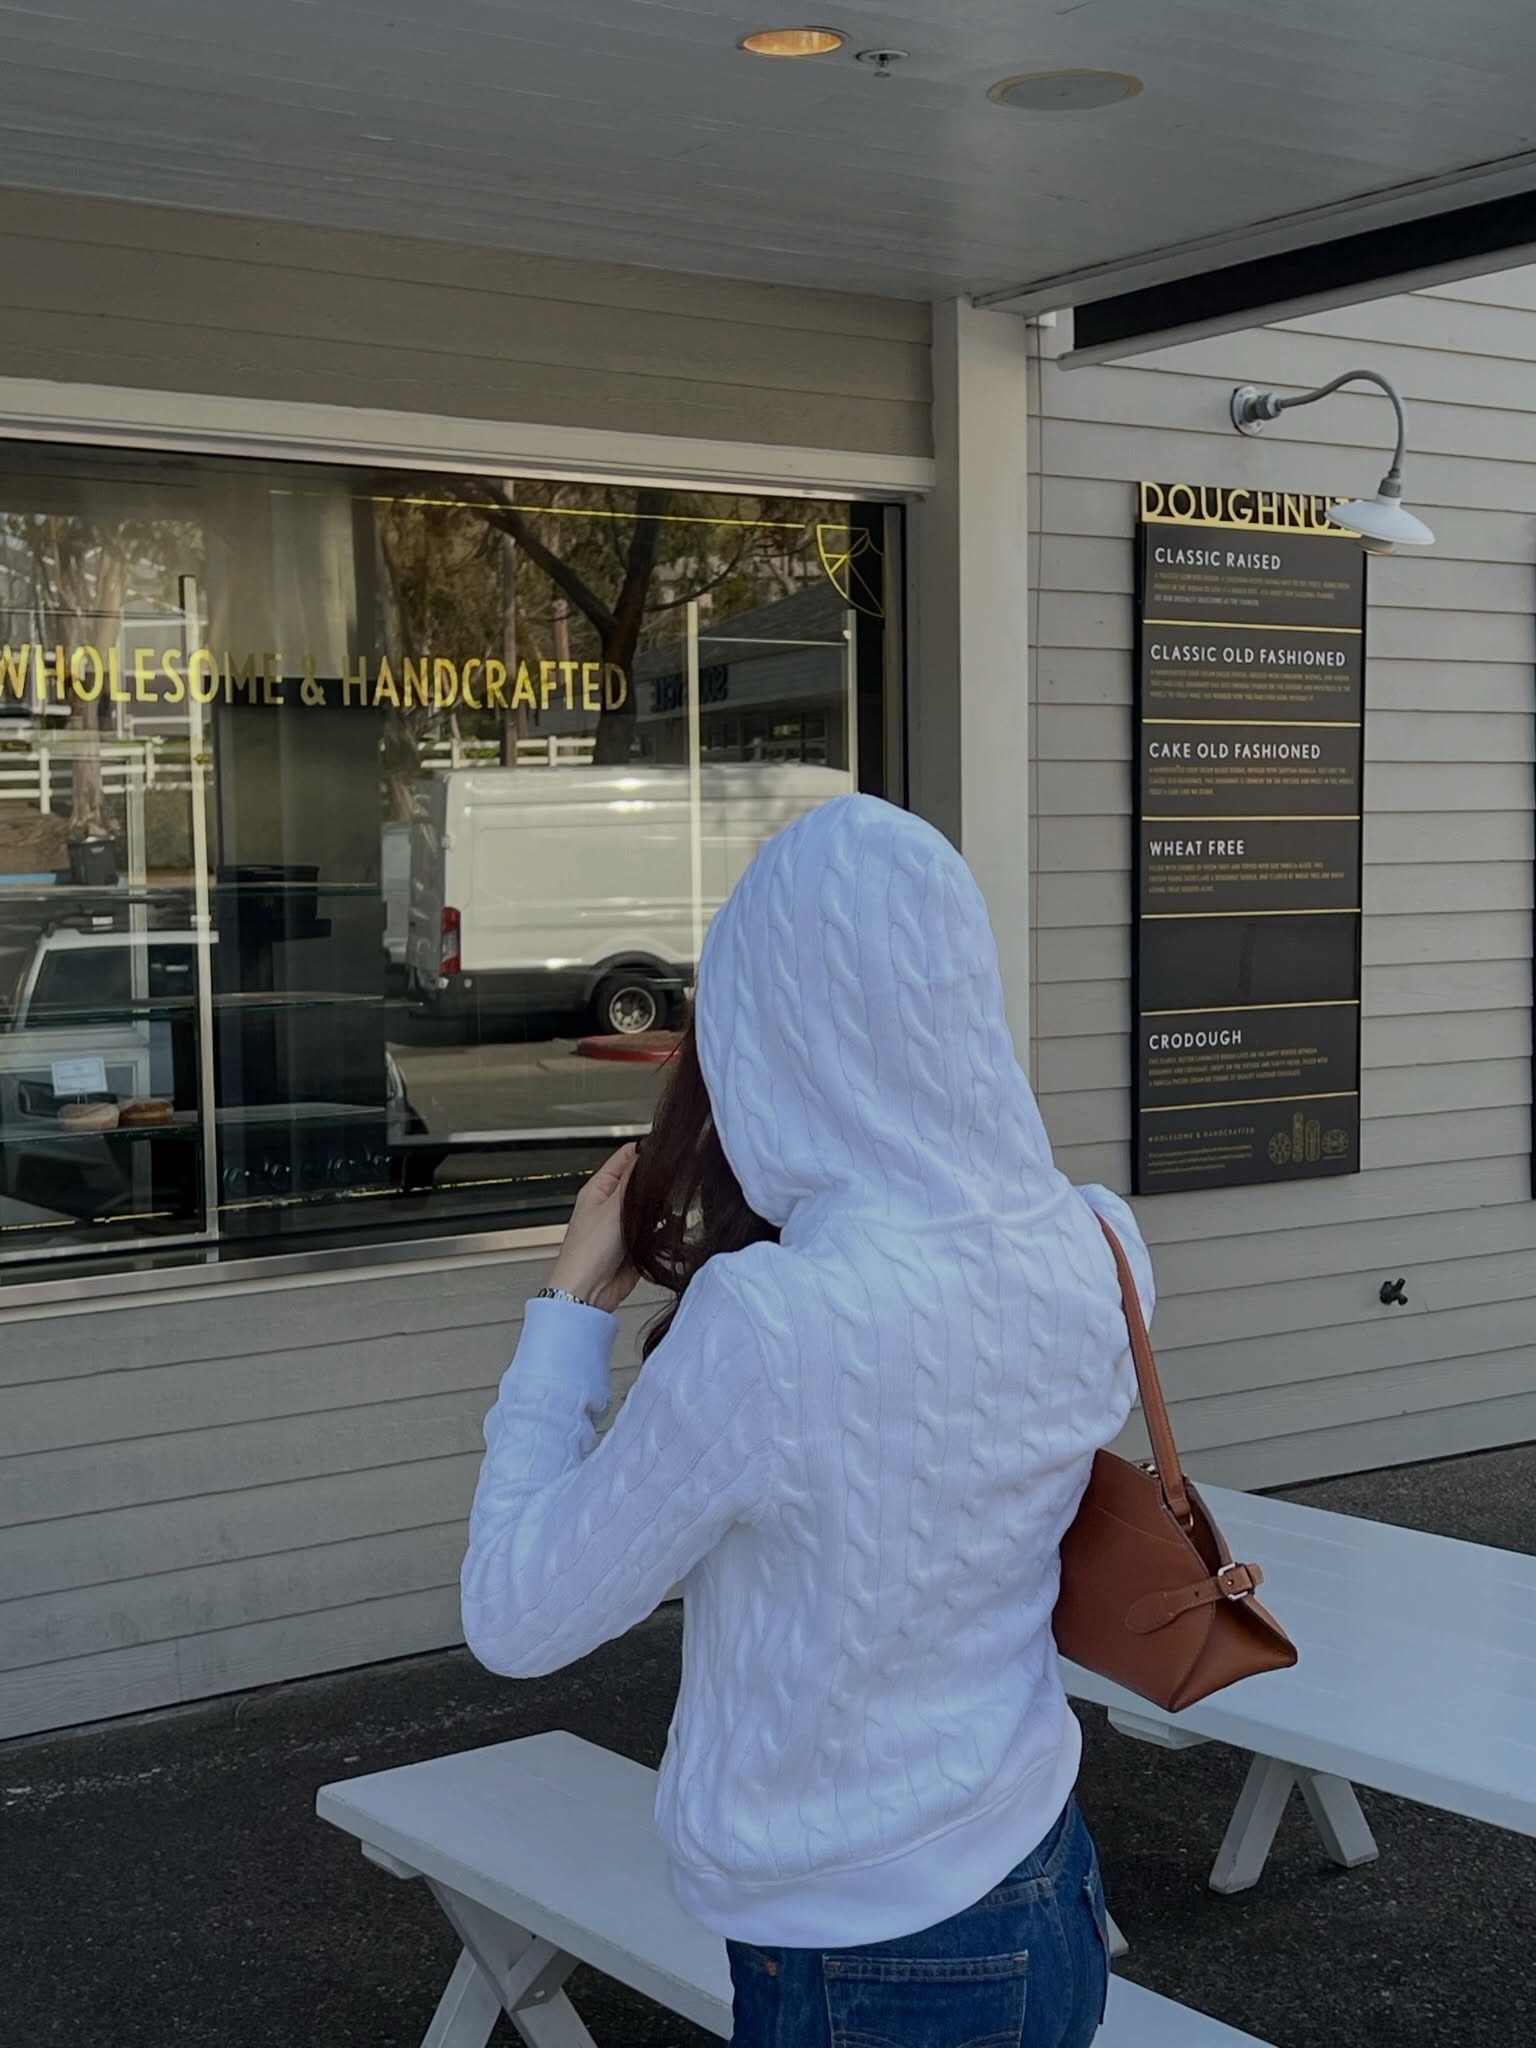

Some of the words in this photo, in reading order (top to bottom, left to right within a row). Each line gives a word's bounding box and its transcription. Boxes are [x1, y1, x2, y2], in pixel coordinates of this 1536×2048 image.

[1142, 481, 1362, 532] DOUGHNUT
[1154, 547, 1220, 567] CLASSIC
[1226, 552, 1281, 570] RAISED
[1150, 644, 1218, 662] CLASSIC
[1223, 647, 1254, 664] OLD
[1260, 648, 1346, 667] FASHIONED
[0, 644, 284, 705] WHOLESOME
[300, 654, 325, 706] &
[342, 656, 628, 711] HANDCRAFTED
[1149, 742, 1191, 759] CAKE
[1197, 743, 1229, 759] OLD
[1235, 743, 1321, 760] FASHIONED
[1149, 840, 1202, 857] WHEAT
[1208, 840, 1245, 856] FREE
[1149, 1029, 1242, 1050] CRODOUGH
